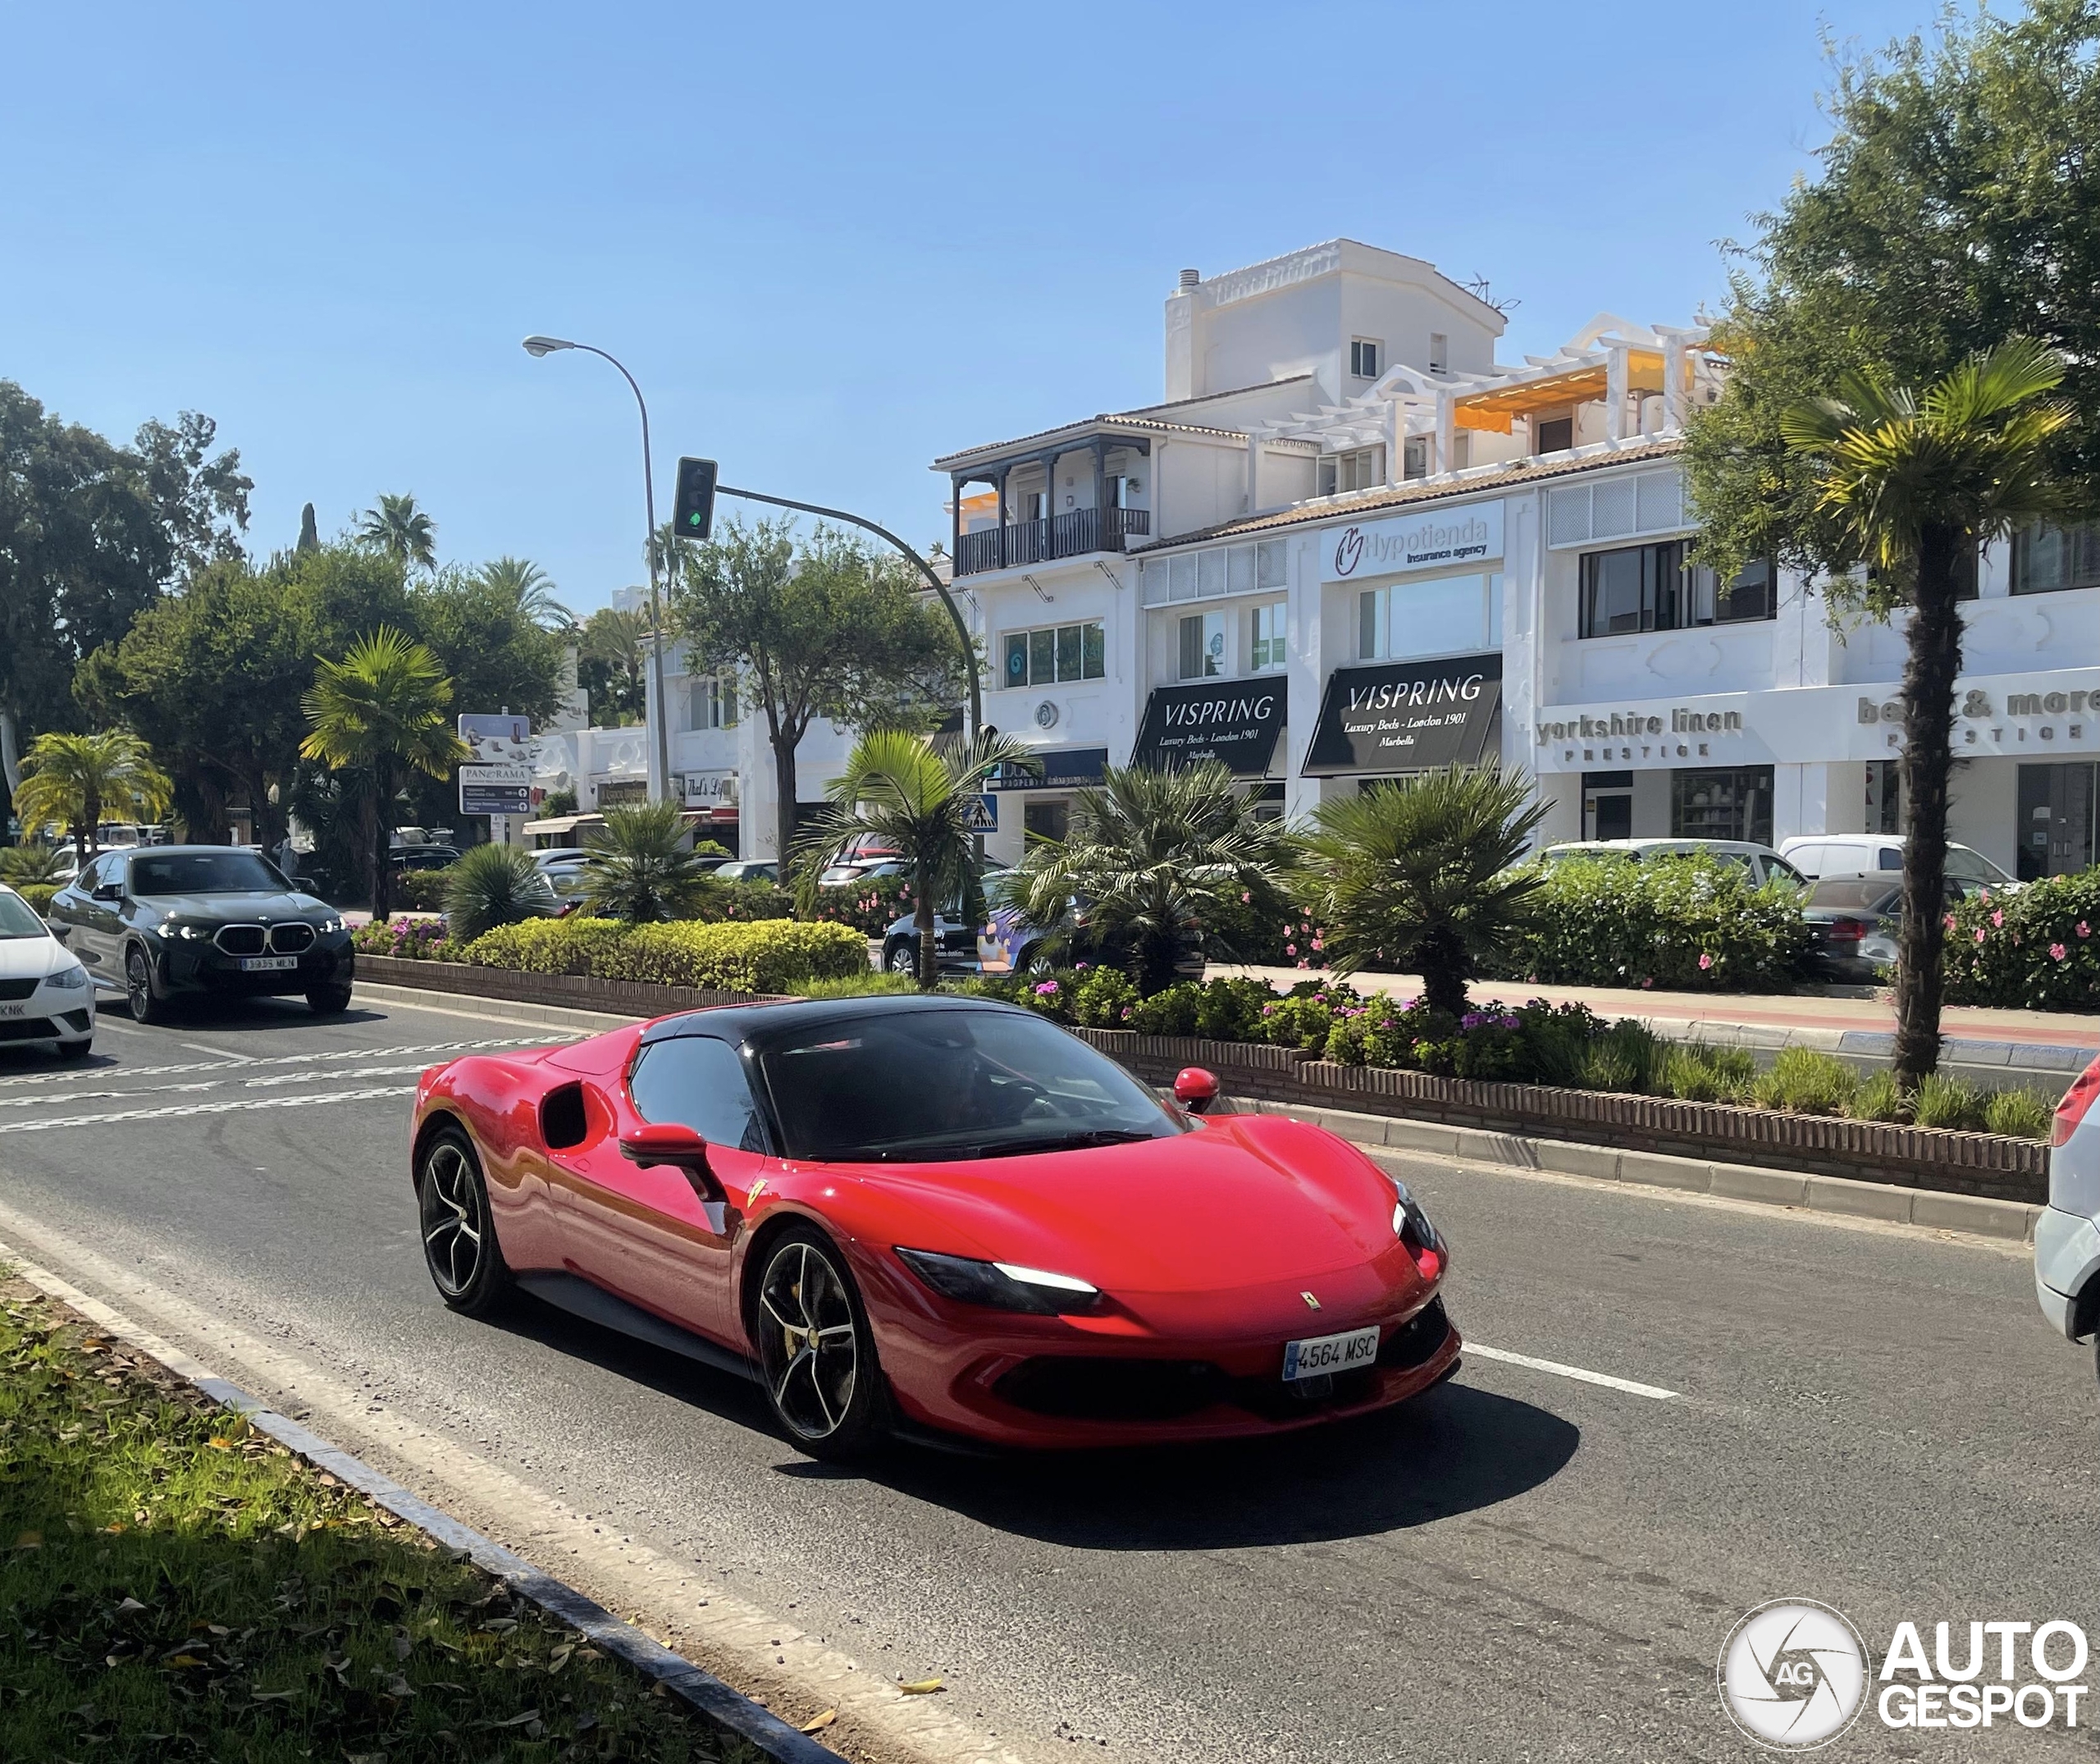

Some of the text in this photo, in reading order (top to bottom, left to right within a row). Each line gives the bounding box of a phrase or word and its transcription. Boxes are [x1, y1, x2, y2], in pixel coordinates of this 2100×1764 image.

[1365, 517, 1487, 563] Hypotienda
[1407, 544, 1486, 564] Insurance agency
[1350, 674, 1483, 711] VISPRING
[1166, 695, 1274, 727] VISPRING
[1344, 722, 1376, 734] Luxury
[1377, 719, 1399, 731] Beds
[1407, 715, 1441, 729] London
[1444, 712, 1467, 725] 1901
[1536, 708, 1742, 747] yorkshire linen
[1159, 737, 1185, 747] Luxury
[1187, 734, 1205, 745] Beds
[1210, 731, 1239, 743] London
[1240, 729, 1259, 740] 1901
[1379, 735, 1414, 747] Marbella
[1887, 724, 2082, 747] PSTIGE
[1565, 743, 1709, 762] PRESTIGE
[1298, 1335, 1376, 1369] 4564 MSC
